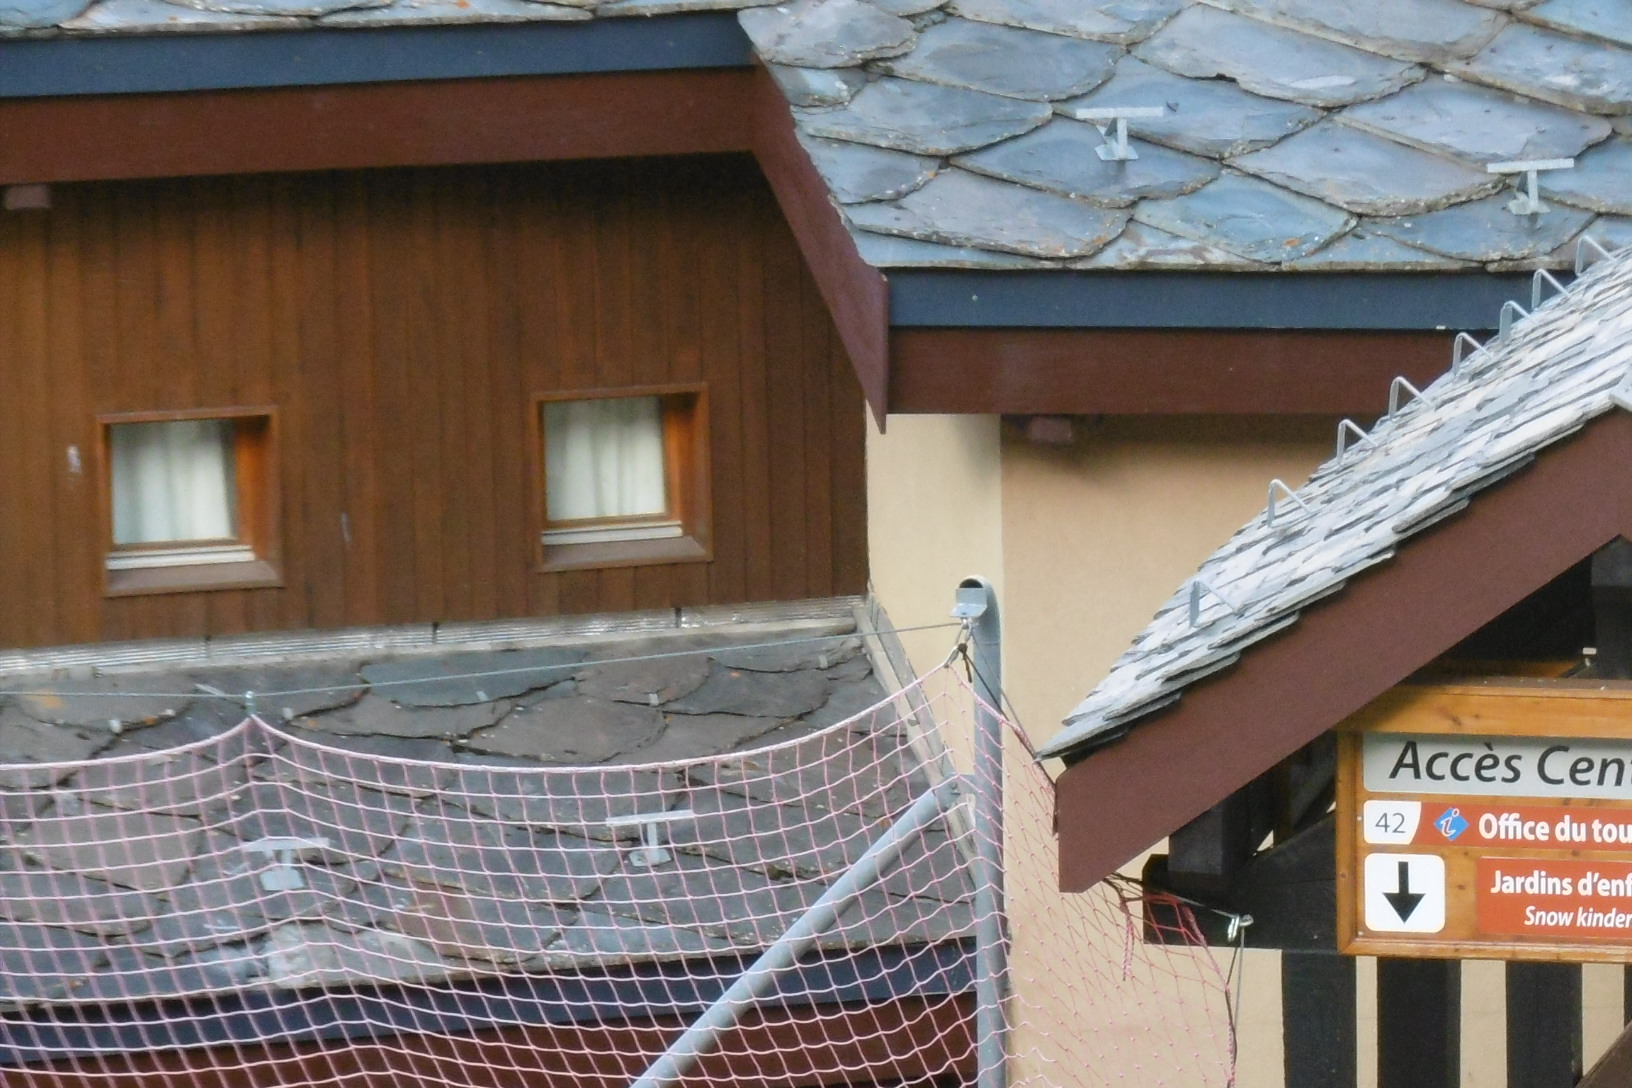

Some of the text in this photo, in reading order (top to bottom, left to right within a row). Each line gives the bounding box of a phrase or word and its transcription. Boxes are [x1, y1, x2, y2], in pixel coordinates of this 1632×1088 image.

[1388, 740, 1523, 784] Accès
[1375, 812, 1406, 834] 42
[1478, 813, 1549, 842] Office
[1555, 815, 1586, 843] du
[1490, 870, 1573, 896] Jardins
[1524, 905, 1574, 927] Snow
